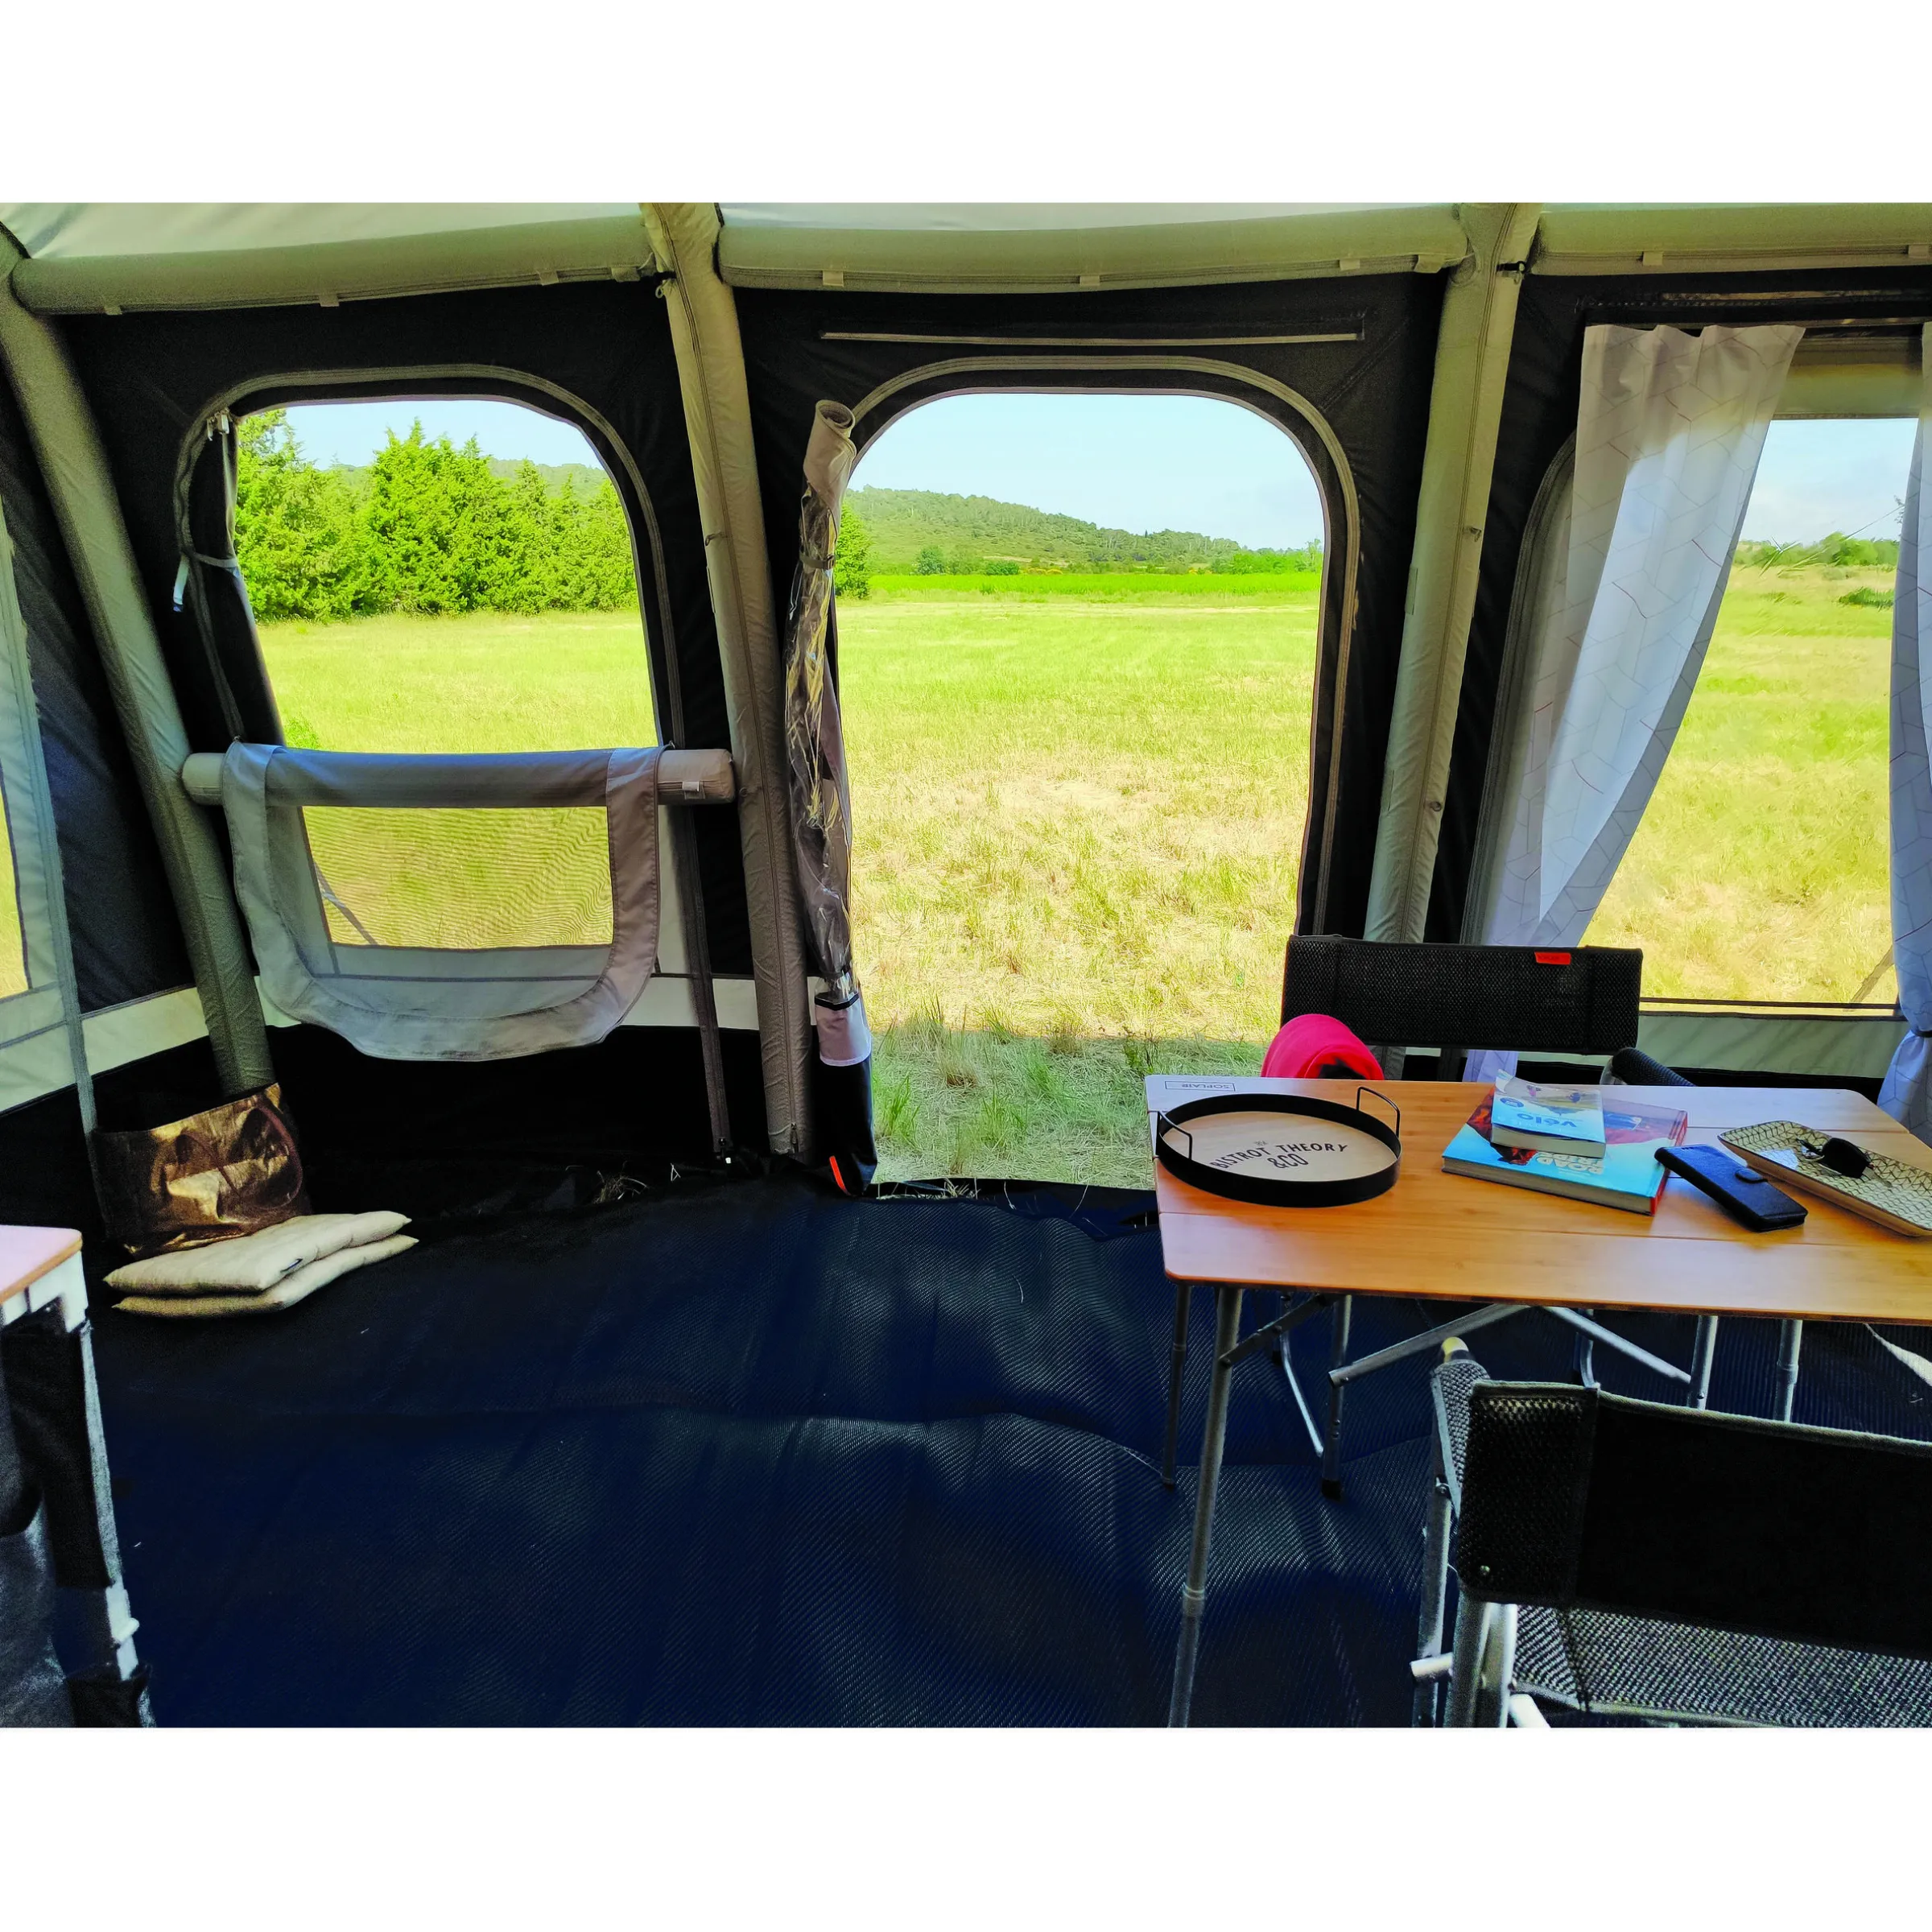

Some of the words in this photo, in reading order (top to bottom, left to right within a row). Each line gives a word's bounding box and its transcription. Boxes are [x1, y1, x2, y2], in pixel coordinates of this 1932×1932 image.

[1210, 1147, 1272, 1168] BISTROT
[1276, 1143, 1348, 1153] THEORY
[1267, 1154, 1309, 1169] &CO
[1537, 1157, 1604, 1174] ROAD
